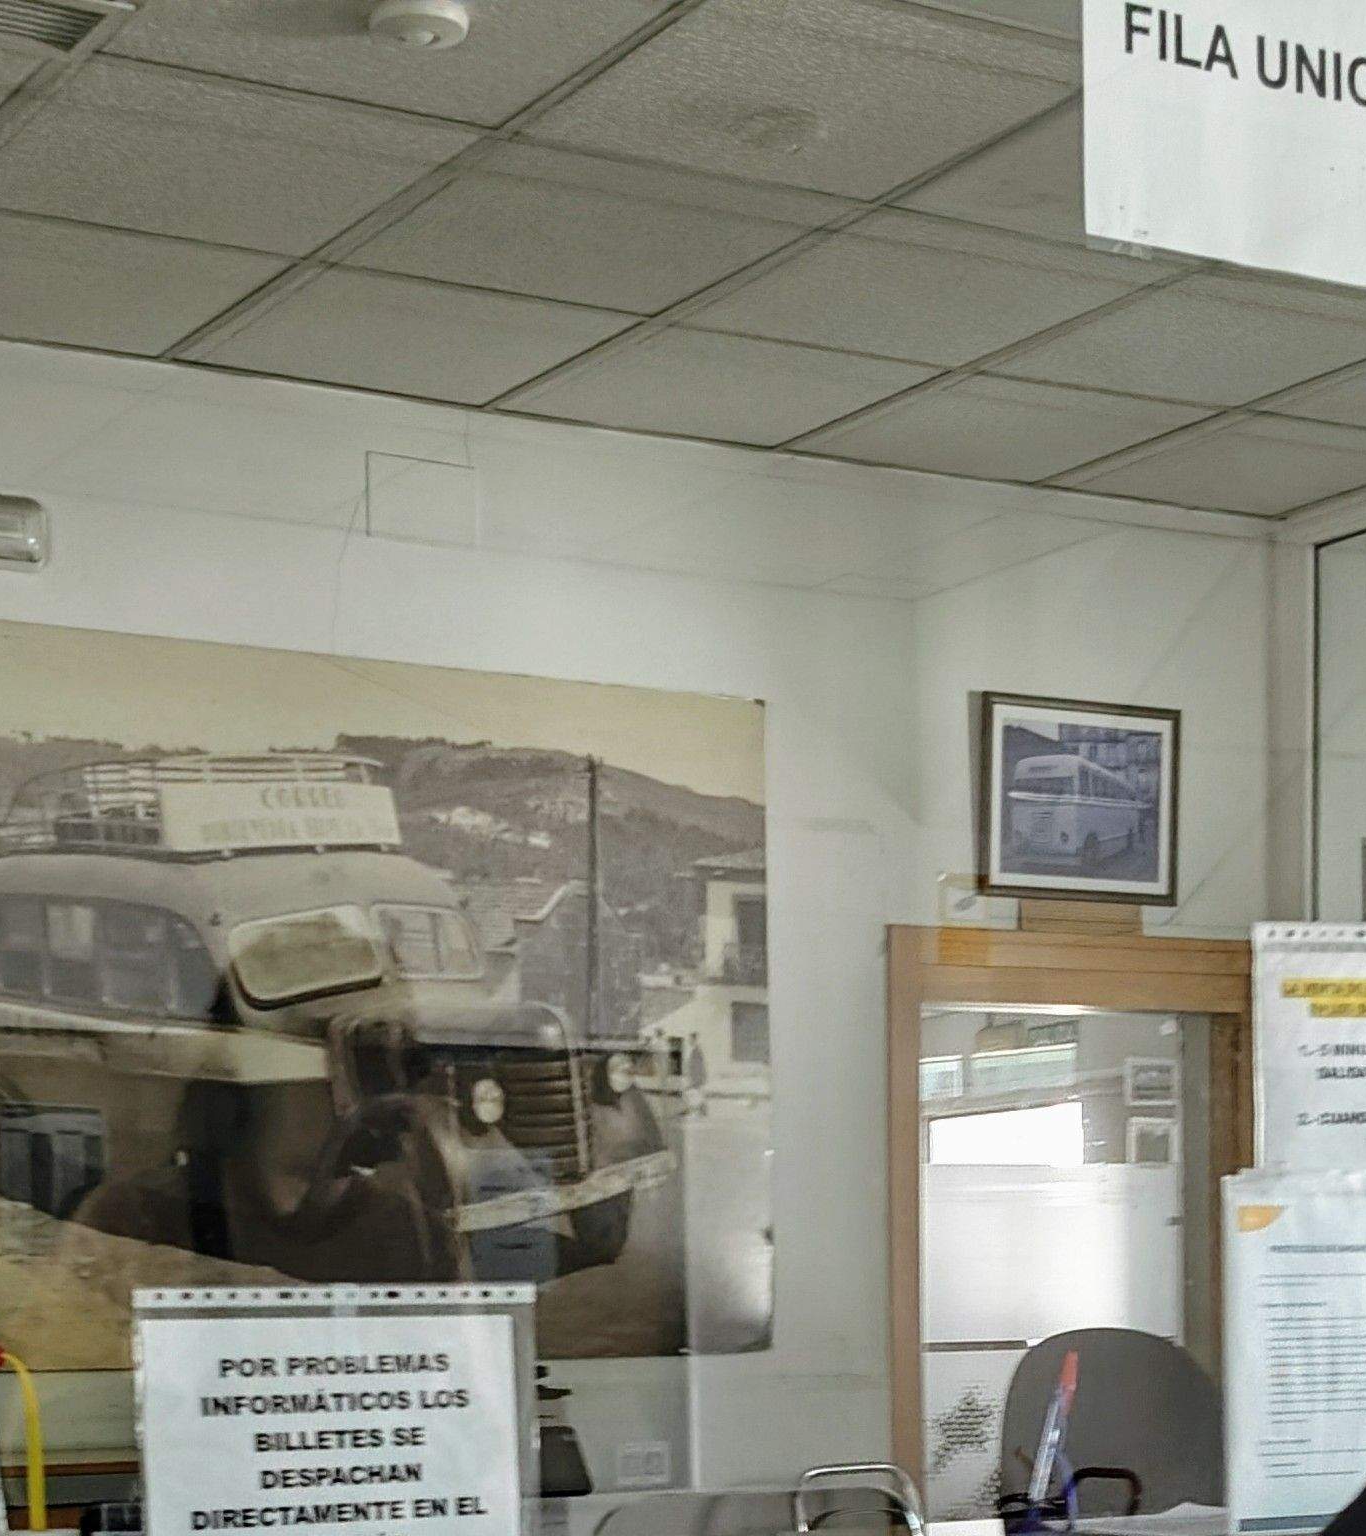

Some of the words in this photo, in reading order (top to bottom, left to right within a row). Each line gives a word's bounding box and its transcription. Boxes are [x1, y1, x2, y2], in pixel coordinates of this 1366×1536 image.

[1124, 2, 1239, 80] FILA
[218, 1357, 277, 1379] POR
[285, 1353, 450, 1377] PROBLEMAS
[200, 1388, 412, 1417] INFORMÁTICOS
[419, 1387, 470, 1410] LOS
[254, 1429, 385, 1453] BILLETES
[391, 1426, 427, 1447] SE
[259, 1462, 423, 1490] DESPACHAN
[190, 1500, 407, 1531] DIRECTAMENTE
[412, 1496, 449, 1519] EN
[454, 1495, 489, 1517] EL
